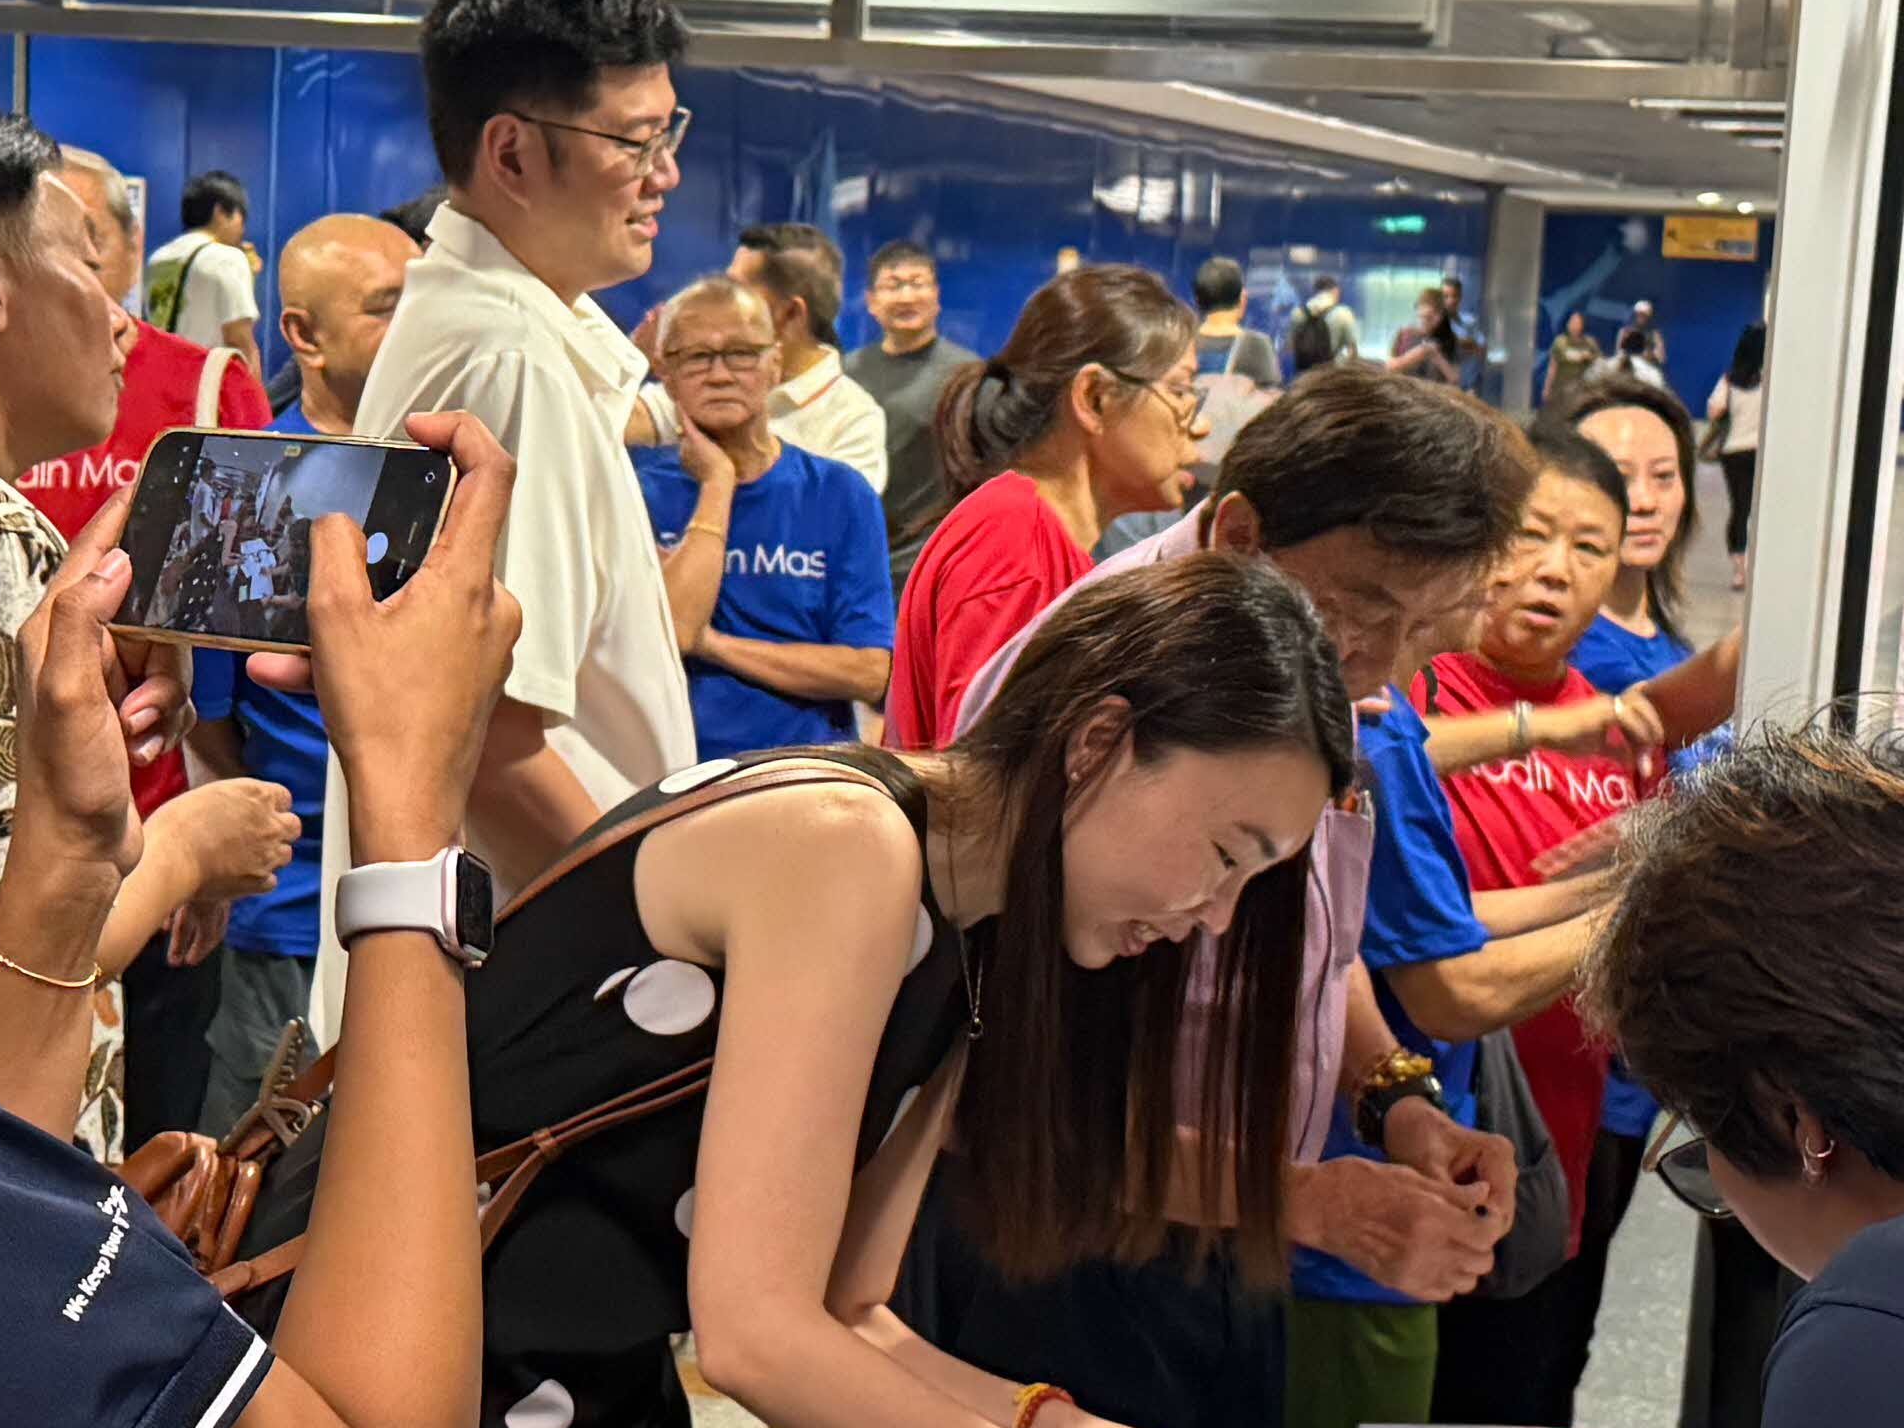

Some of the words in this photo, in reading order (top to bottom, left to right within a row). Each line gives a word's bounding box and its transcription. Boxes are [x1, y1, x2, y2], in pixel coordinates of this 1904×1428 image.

[752, 542, 826, 580] Mas
[62, 1293, 89, 1322] We
[77, 1255, 112, 1297] Keep
